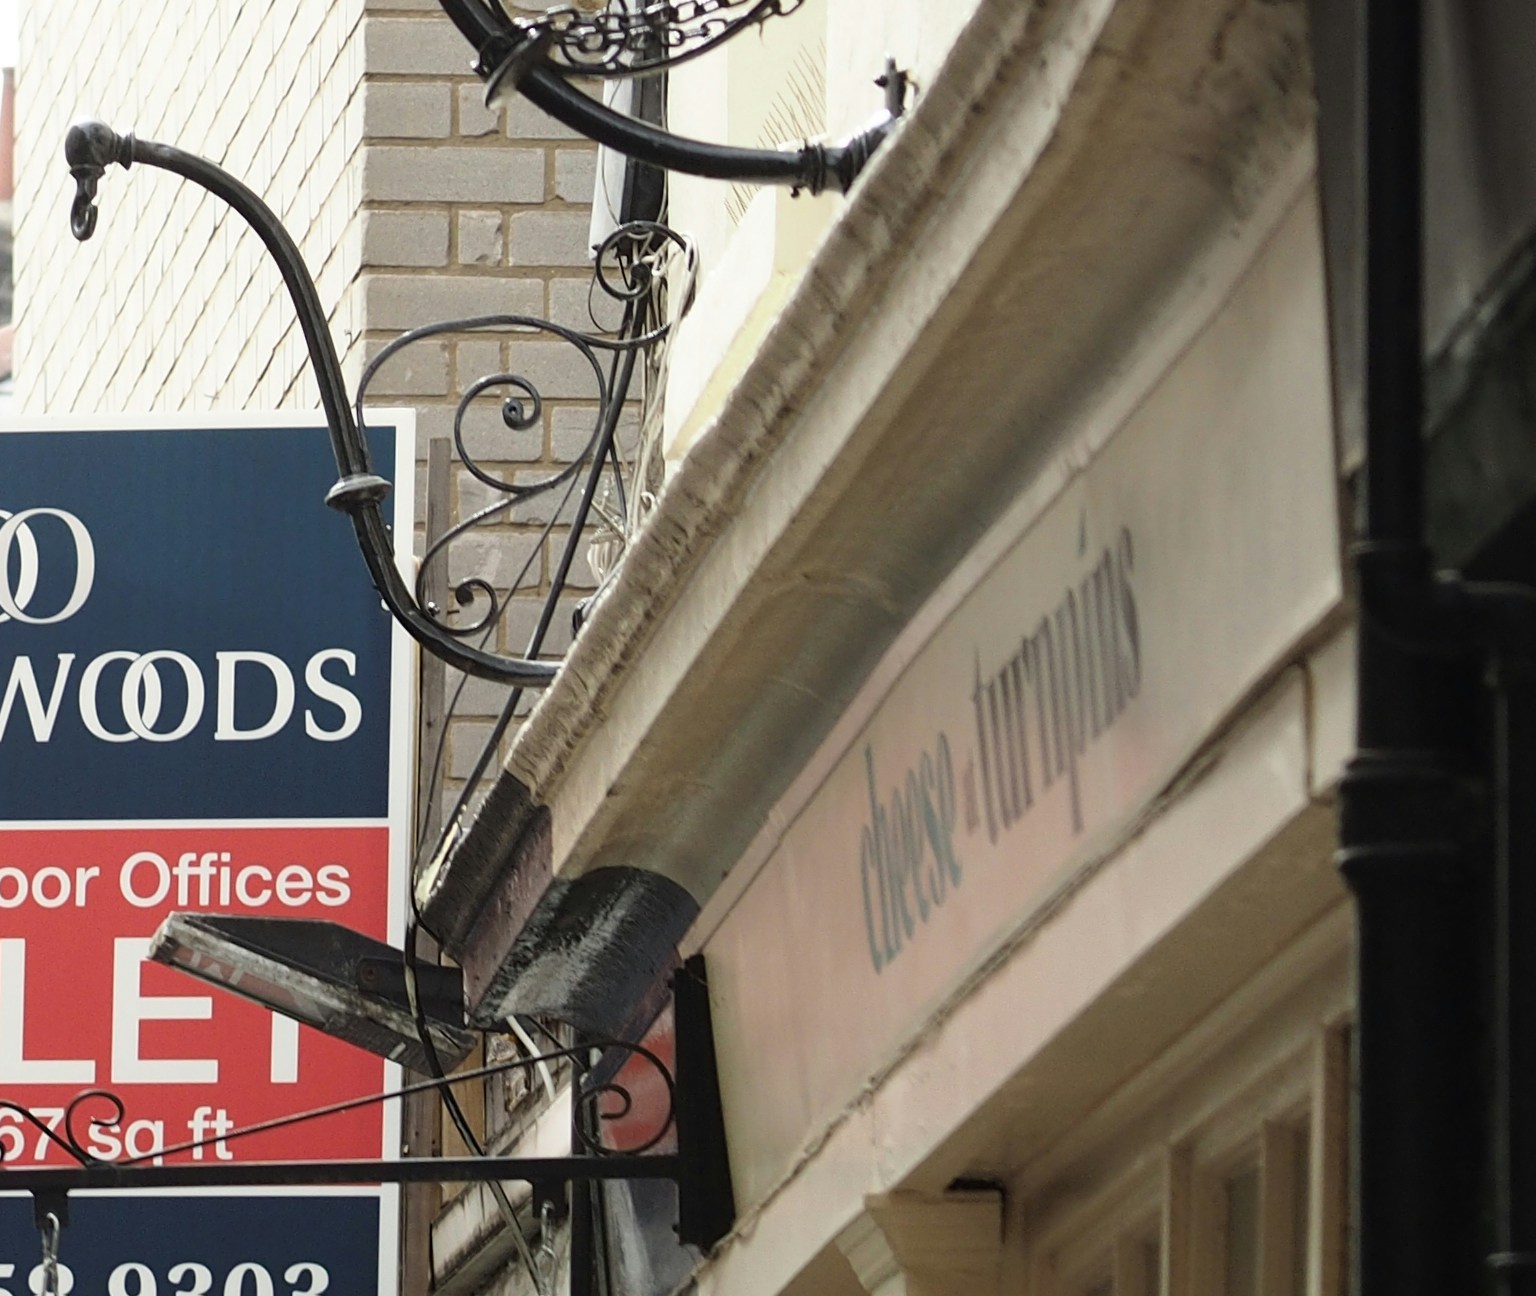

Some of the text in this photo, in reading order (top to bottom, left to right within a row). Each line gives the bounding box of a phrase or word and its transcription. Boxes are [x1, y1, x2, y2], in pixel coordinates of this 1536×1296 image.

[119, 850, 352, 908] Offices
[87, 1112, 165, 1168] sq
[186, 1105, 235, 1162] ft
